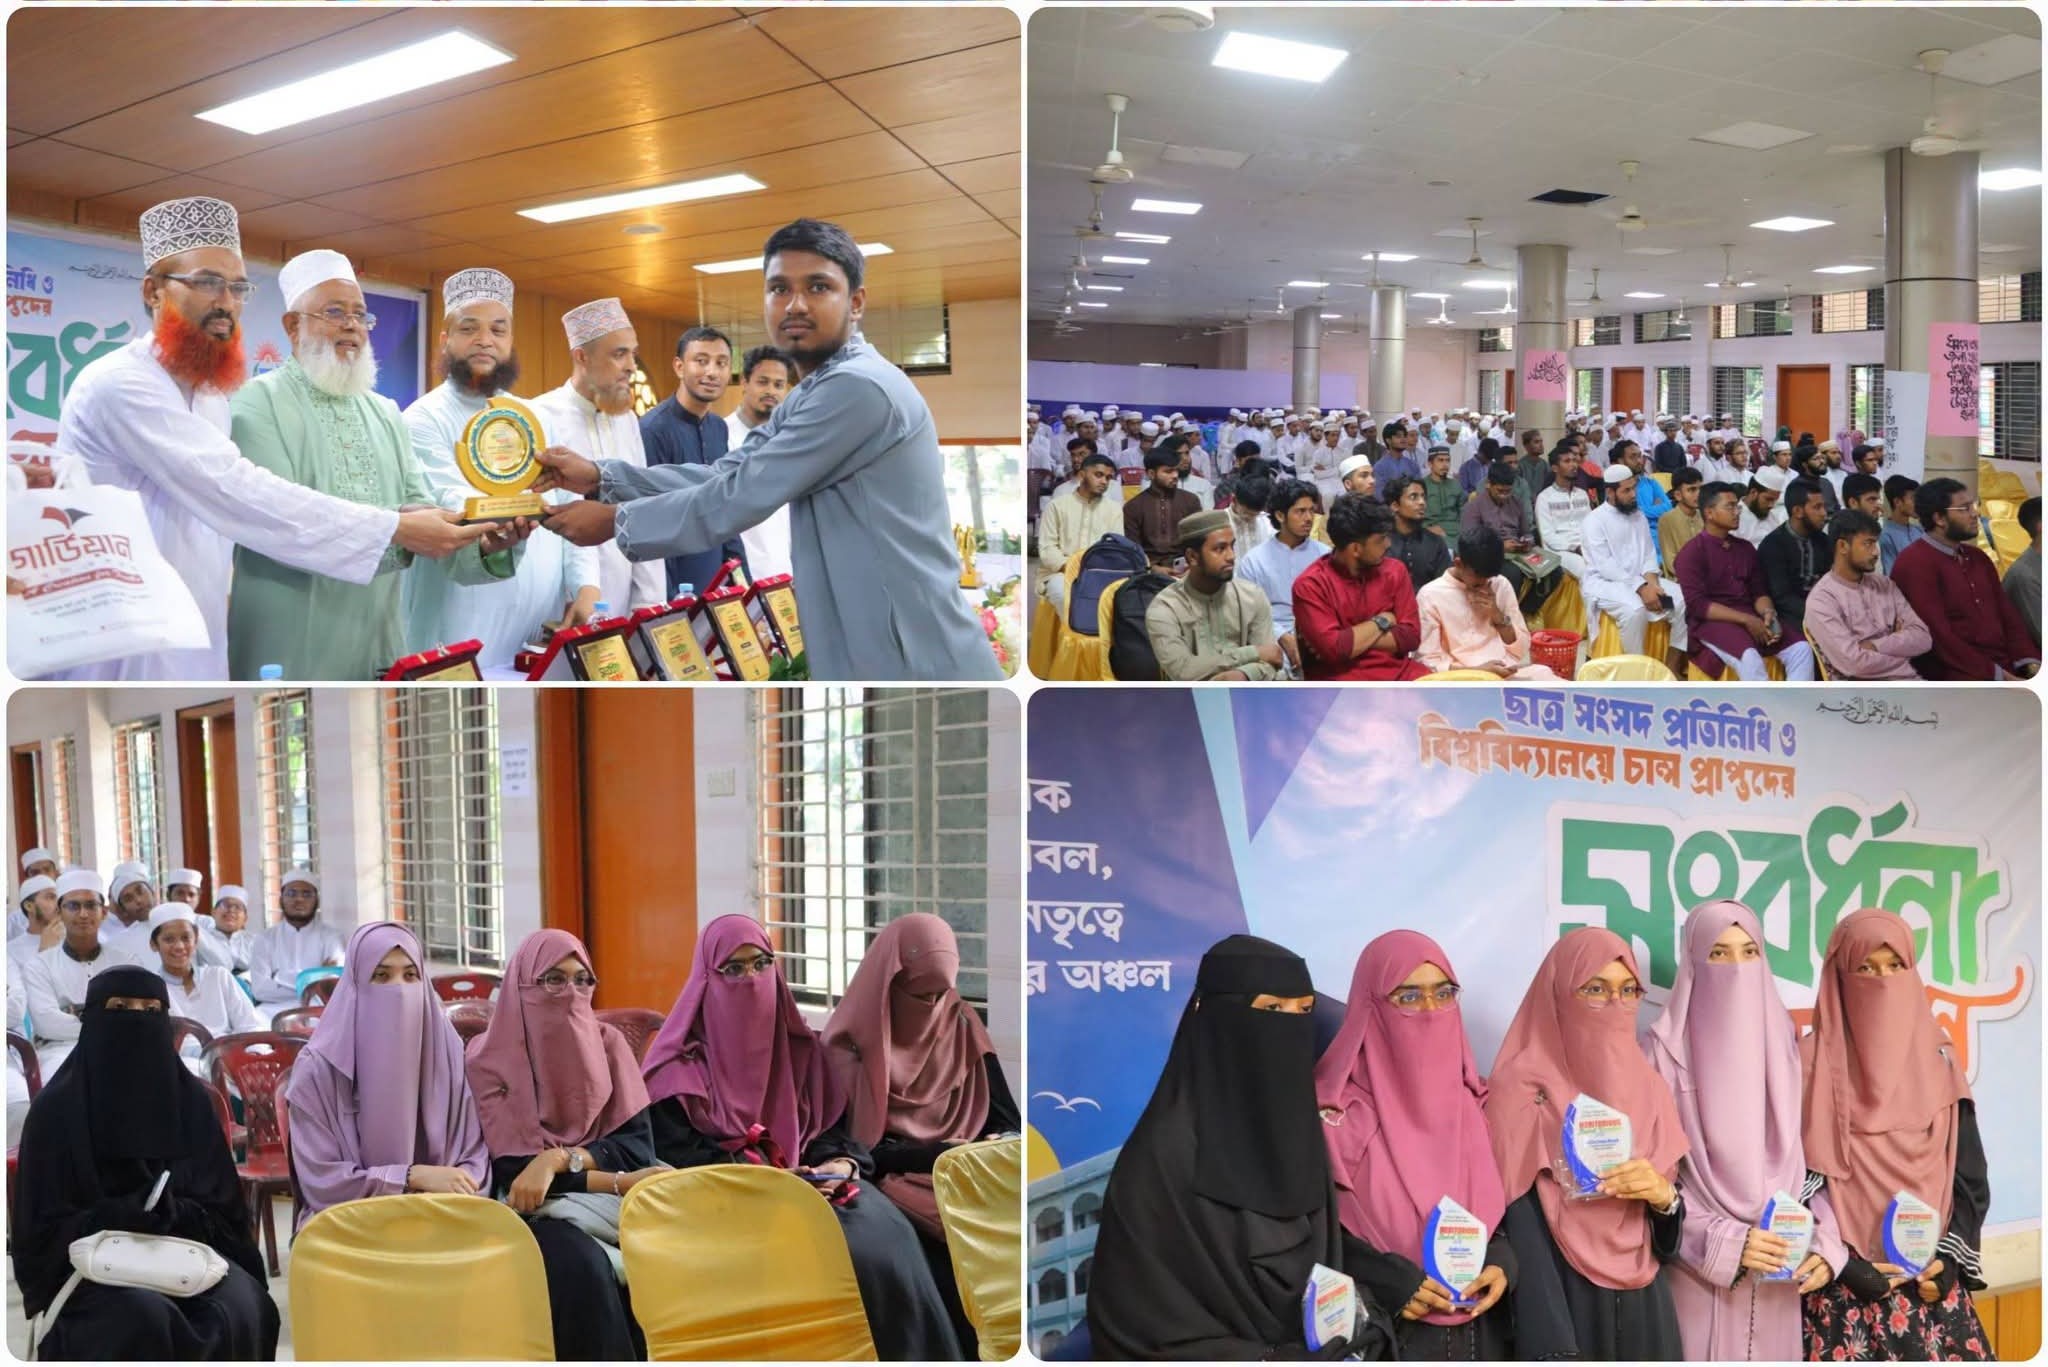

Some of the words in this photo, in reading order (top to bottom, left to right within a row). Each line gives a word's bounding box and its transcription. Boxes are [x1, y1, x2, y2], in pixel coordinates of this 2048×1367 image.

[10, 533, 133, 570] গার্ডিয়ান
[1503, 687, 1564, 733] ছাত্র
[1573, 693, 1653, 740] সংসদ
[1663, 699, 1771, 751] প্রতিনিধি
[1779, 723, 1796, 756] ও
[1419, 713, 1615, 784] বিশ্ববিদ্যালয়ে
[1690, 757, 1795, 801] প্রাপ্তদের
[1056, 960, 1172, 993] অঞ্চল
